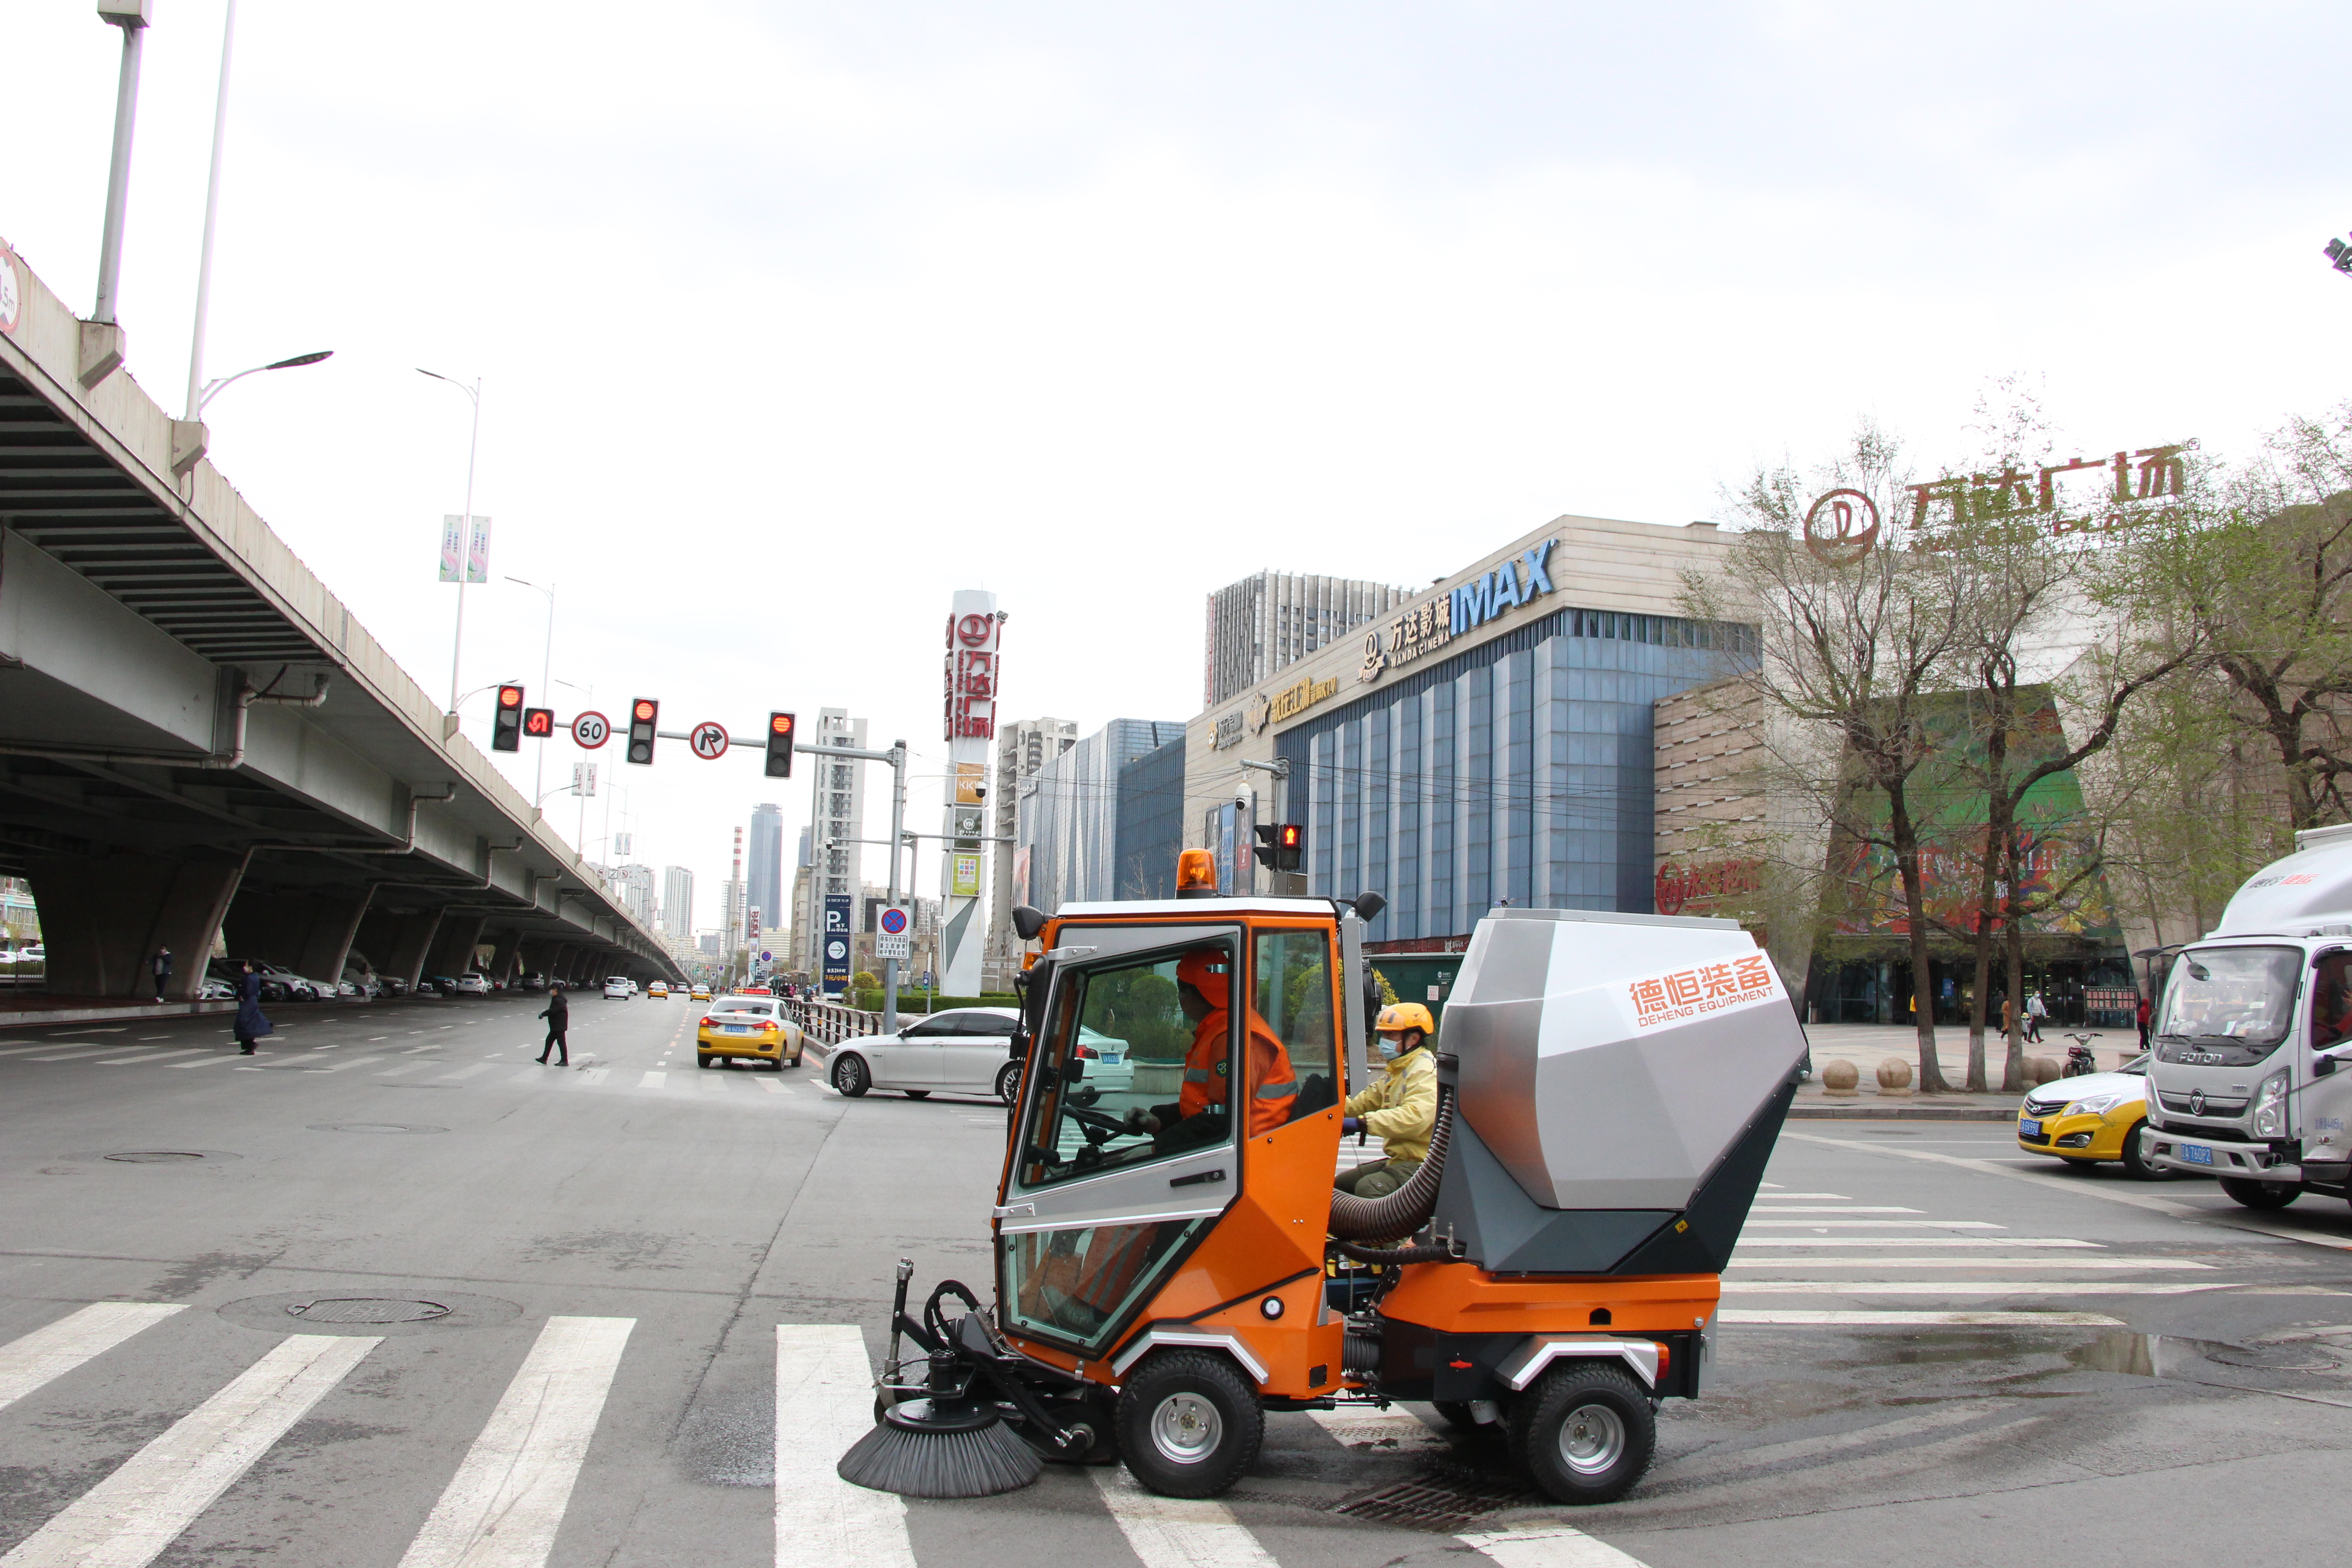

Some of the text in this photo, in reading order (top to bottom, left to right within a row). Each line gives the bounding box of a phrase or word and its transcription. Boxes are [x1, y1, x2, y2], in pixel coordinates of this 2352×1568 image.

[1390, 541, 1553, 652] 万达影城 IMAX
[1390, 630, 1450, 668] WANDA CINEMA
[962, 651, 992, 737] 万达广场
[579, 721, 602, 740] 60
[827, 911, 841, 932] P
[1629, 955, 1771, 1015] 德恒装备
[1638, 986, 1774, 1028] DEHENG EQUIPMENT
[2179, 1052, 2223, 1065] FOTON
